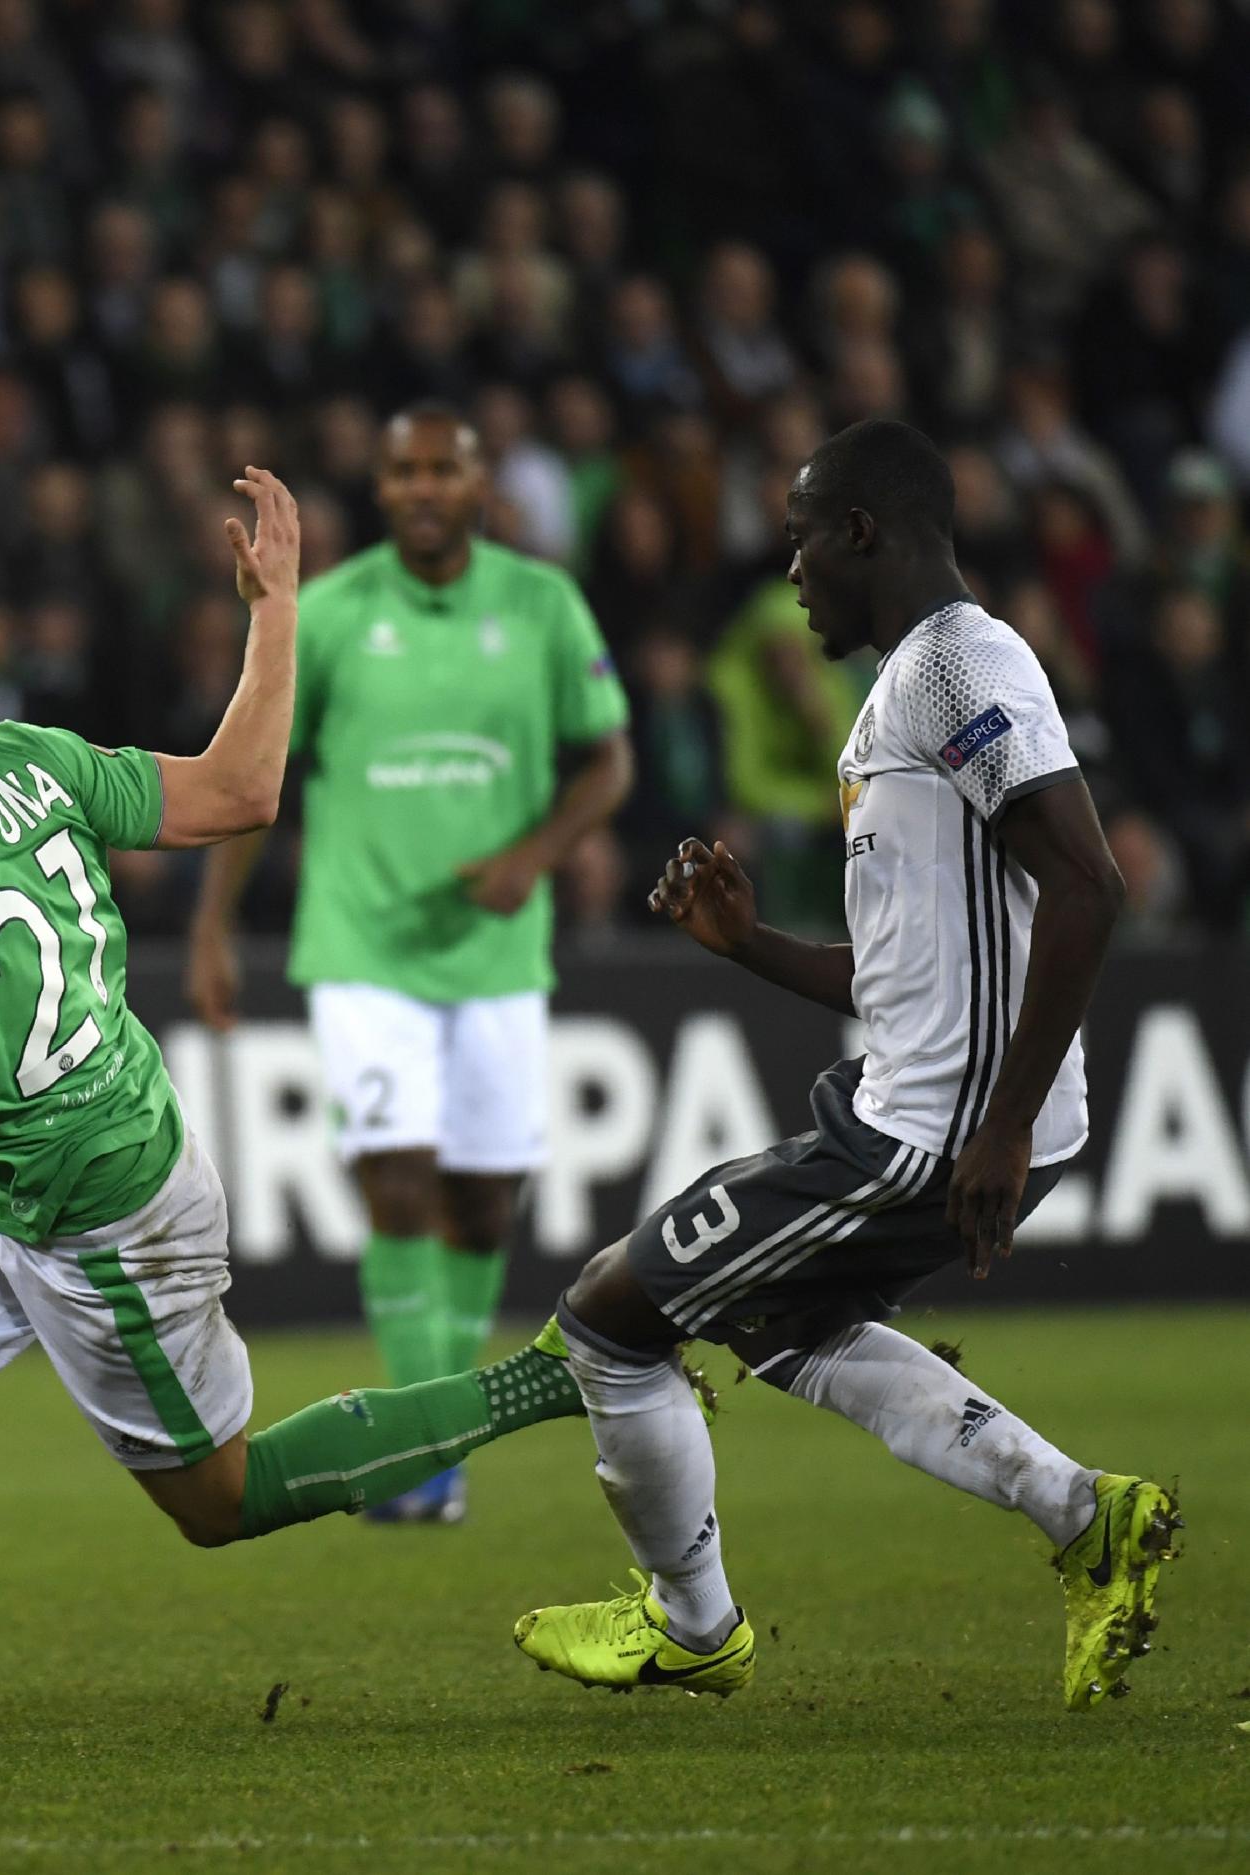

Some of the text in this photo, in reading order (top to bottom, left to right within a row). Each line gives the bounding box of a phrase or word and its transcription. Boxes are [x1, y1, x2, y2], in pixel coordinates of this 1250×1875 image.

[958, 712, 1005, 754] RESPECT
[356, 1066, 398, 1128] 2
[661, 1184, 741, 1264] 3
[960, 1407, 1002, 1448] adidas
